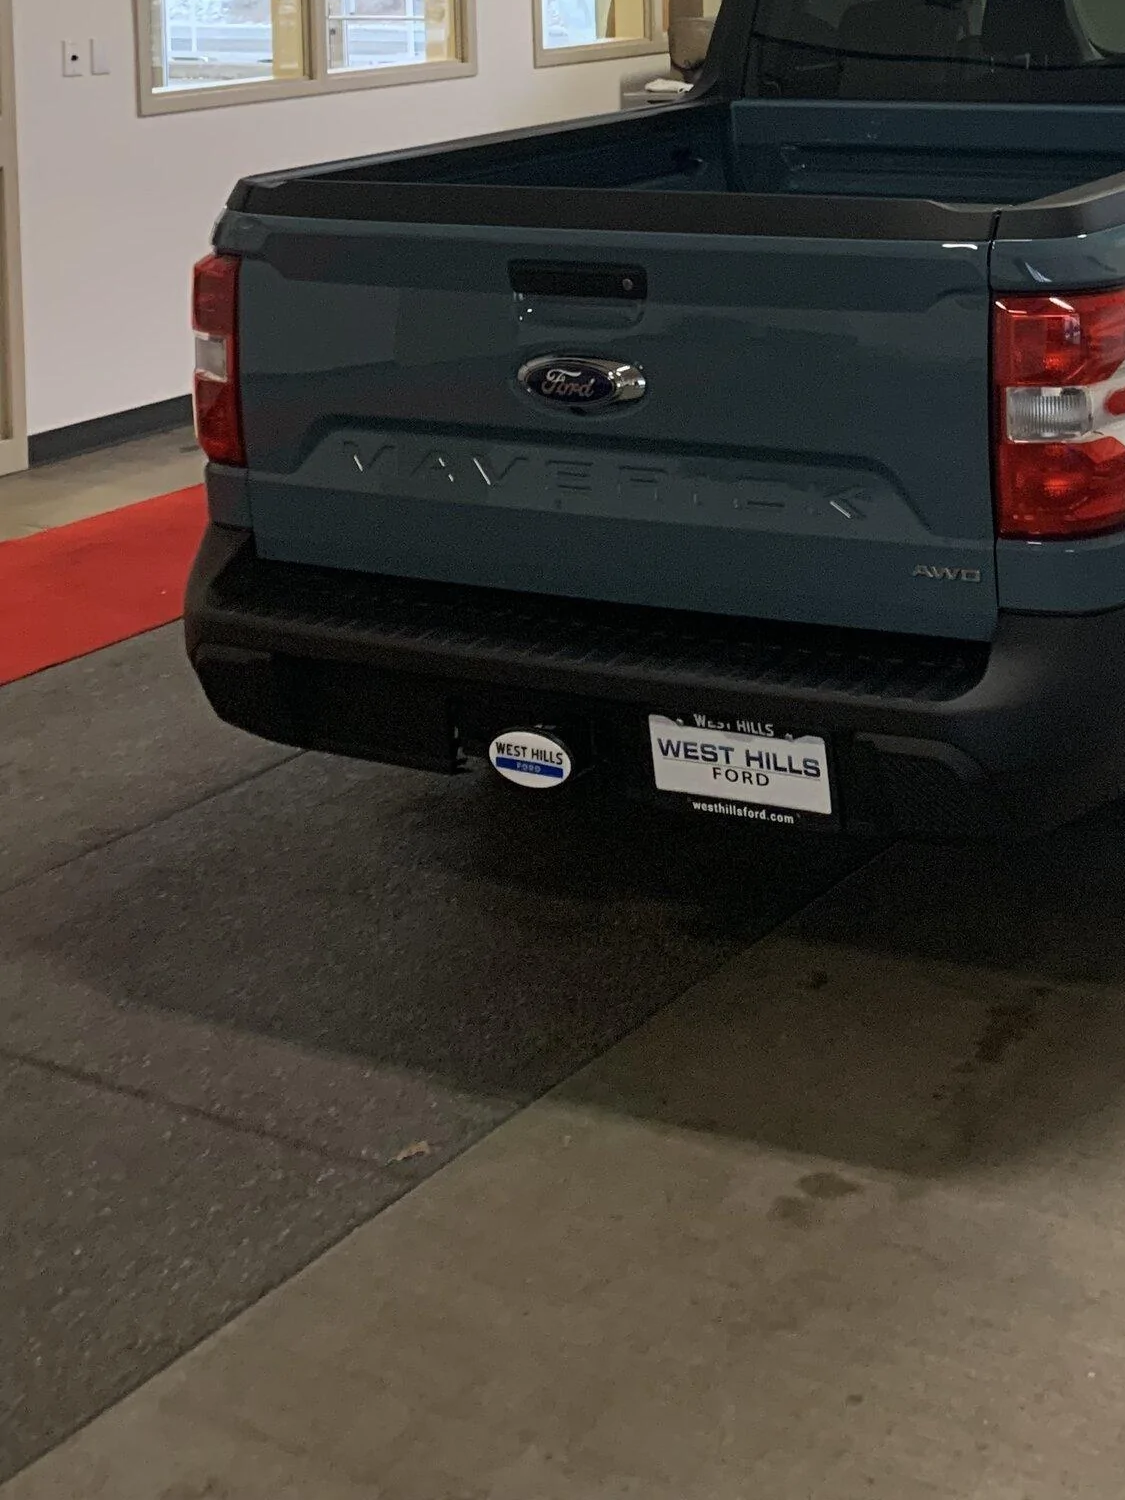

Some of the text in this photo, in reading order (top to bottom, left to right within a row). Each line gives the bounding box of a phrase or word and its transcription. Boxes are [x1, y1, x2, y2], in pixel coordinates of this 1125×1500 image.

[541, 369, 597, 397] Ford
[913, 565, 981, 582] AWD
[736, 720, 775, 737] HILLS
[496, 742, 563, 765] WEST HILLS
[657, 738, 821, 778] WEST HILLS
[516, 762, 541, 773] FORD
[712, 767, 770, 786] FORD
[692, 801, 795, 824] westhillsford.com
